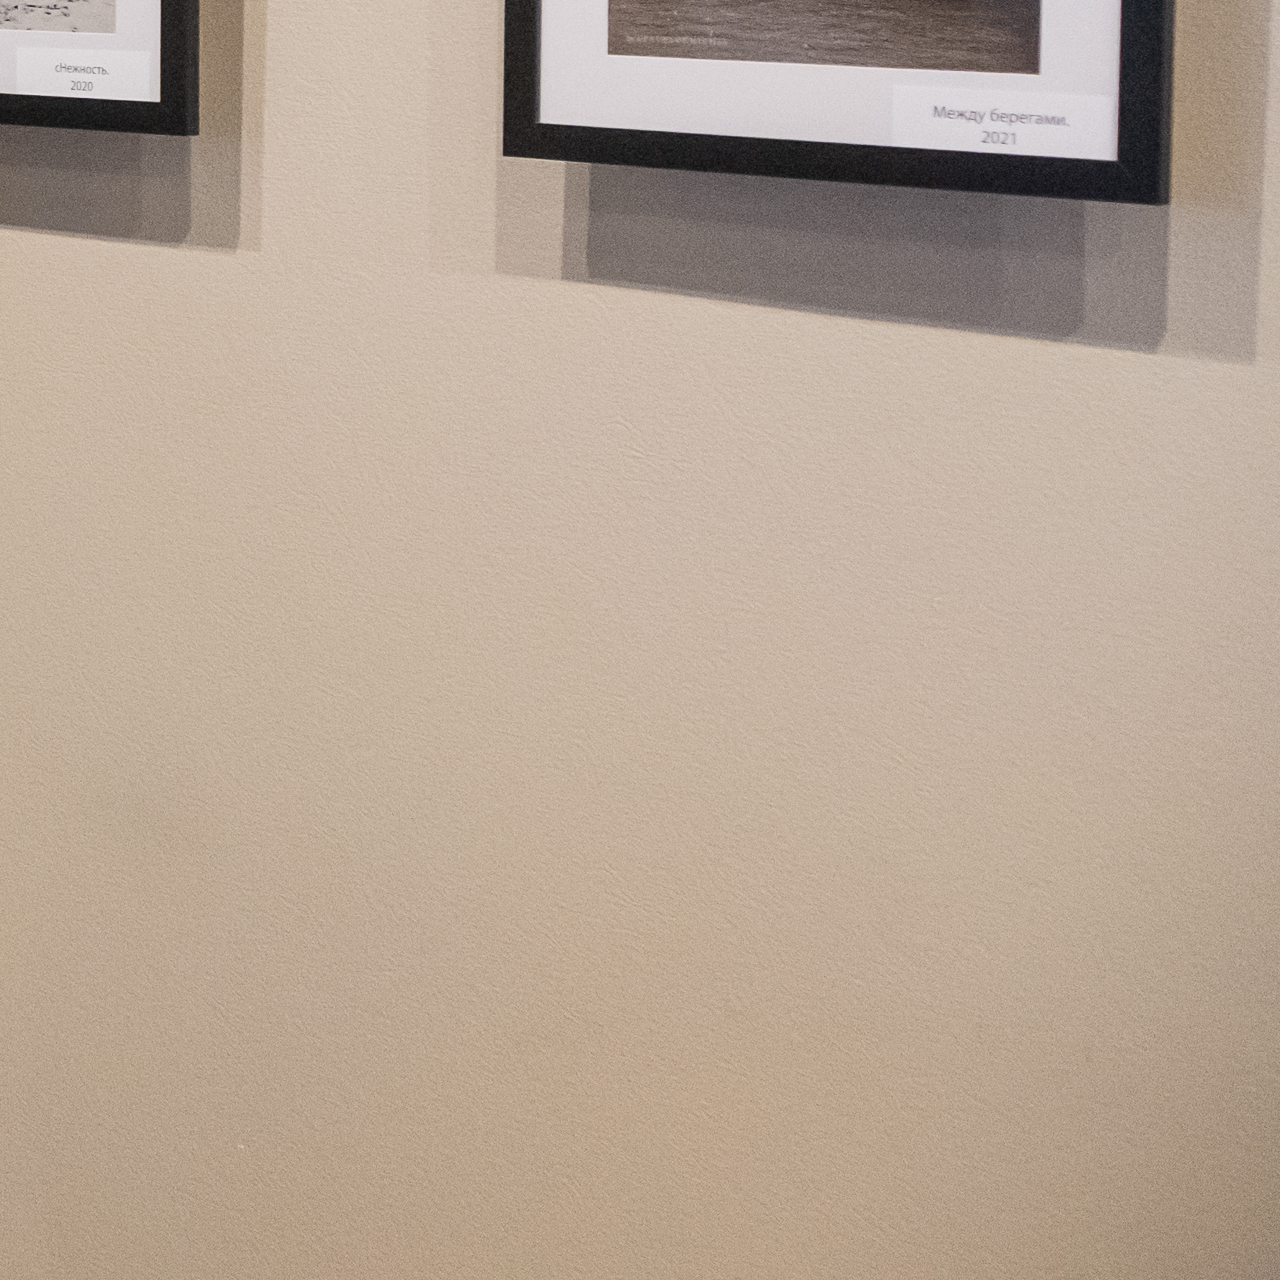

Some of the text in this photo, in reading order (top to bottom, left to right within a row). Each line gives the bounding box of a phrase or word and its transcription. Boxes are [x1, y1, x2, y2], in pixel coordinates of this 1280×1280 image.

[54, 62, 110, 75] сНежность.
[70, 80, 94, 92] 2020
[933, 105, 1071, 127] Между берегами.
[981, 130, 1017, 146] 2021
